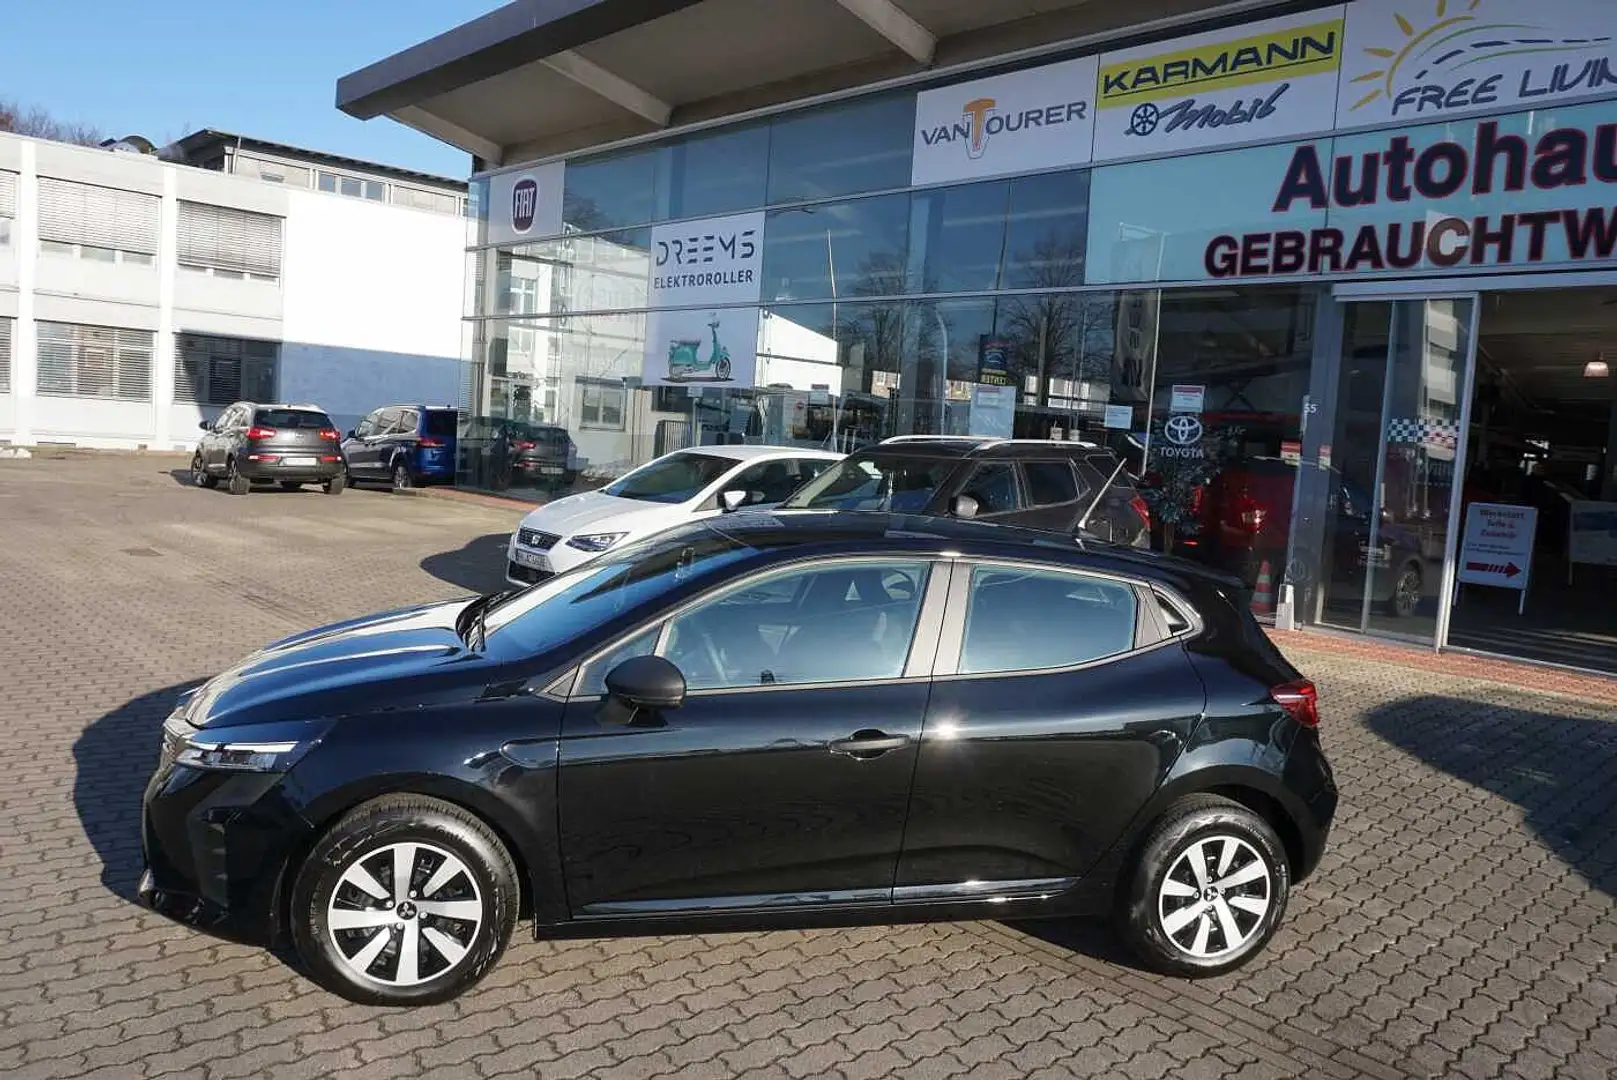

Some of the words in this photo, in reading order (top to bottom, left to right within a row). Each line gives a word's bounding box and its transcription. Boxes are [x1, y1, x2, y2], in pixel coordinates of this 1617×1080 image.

[1102, 31, 1336, 95] KARMANN
[1391, 73, 1504, 116] FREE
[514, 187, 536, 219] FIAT
[655, 229, 757, 267] DREEMS
[1203, 206, 1617, 278] GEBRAUCHTW
[652, 269, 754, 290] ELEKTROROLLER
[1159, 447, 1205, 460] TOYOTA
